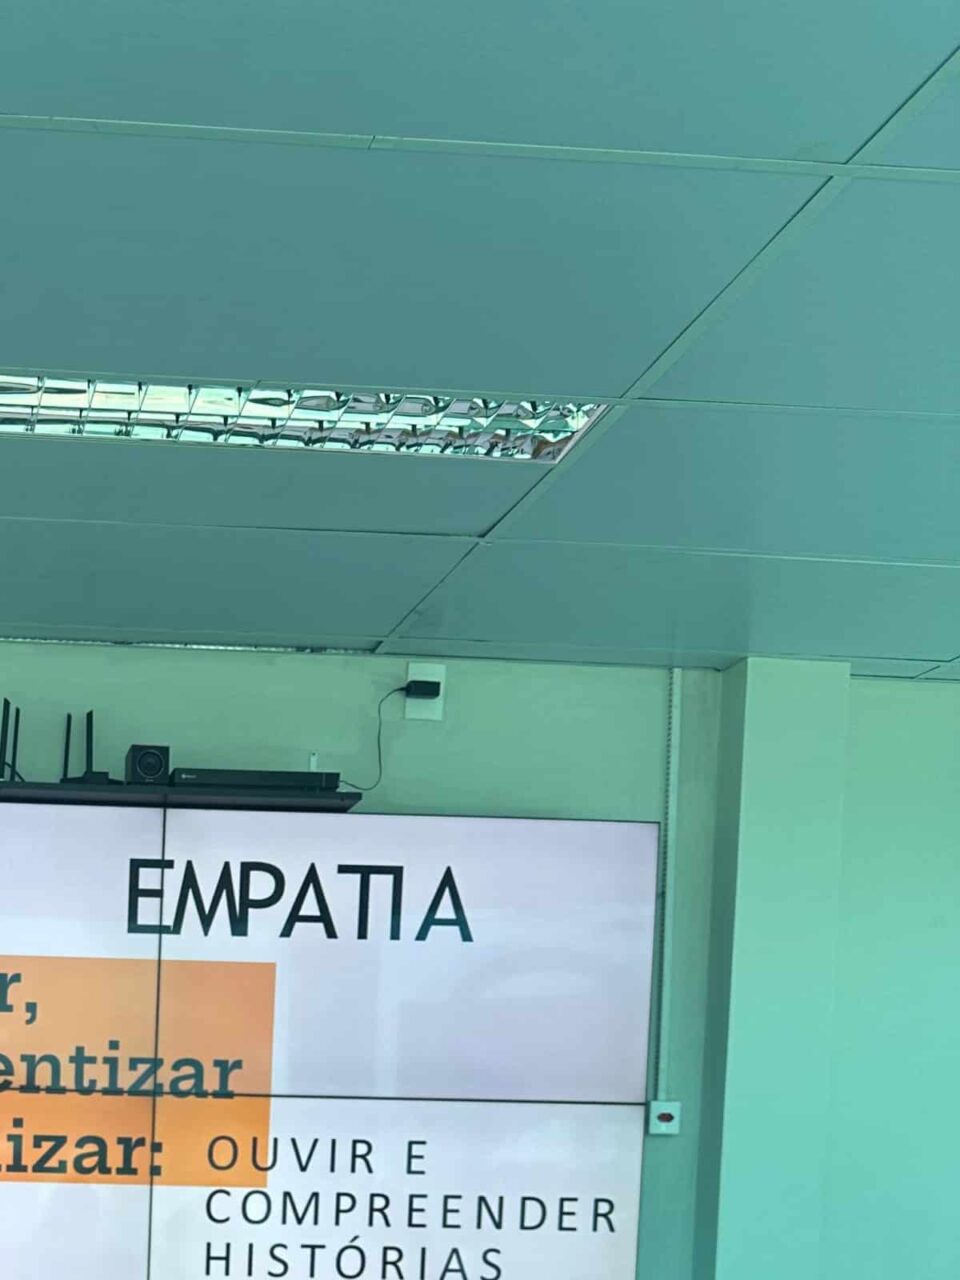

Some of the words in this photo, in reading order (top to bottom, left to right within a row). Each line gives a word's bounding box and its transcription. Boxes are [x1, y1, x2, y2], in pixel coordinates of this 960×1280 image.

[128, 858, 474, 942] EMPATIA
[207, 1135, 375, 1174] OUVIR
[405, 1140, 428, 1176] E
[205, 1189, 617, 1233] COMPREENDER
